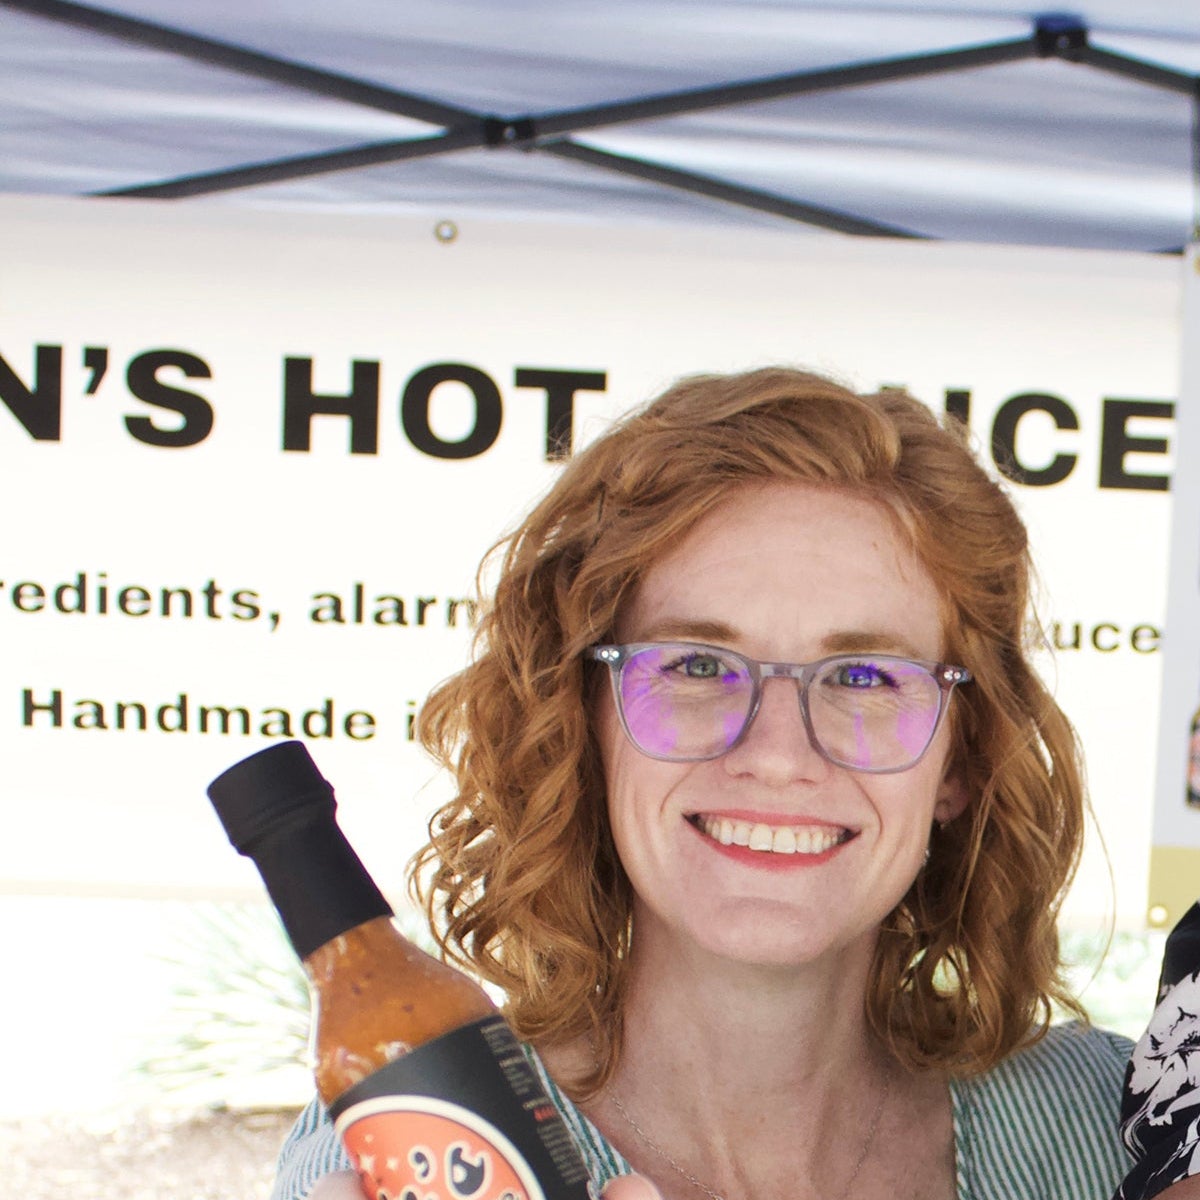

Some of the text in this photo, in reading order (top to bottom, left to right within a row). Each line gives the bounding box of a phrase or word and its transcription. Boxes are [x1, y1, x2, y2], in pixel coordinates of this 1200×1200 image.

[281, 355, 608, 463] HOT
[0, 572, 282, 632] edients,
[22, 687, 377, 741] Handmade
